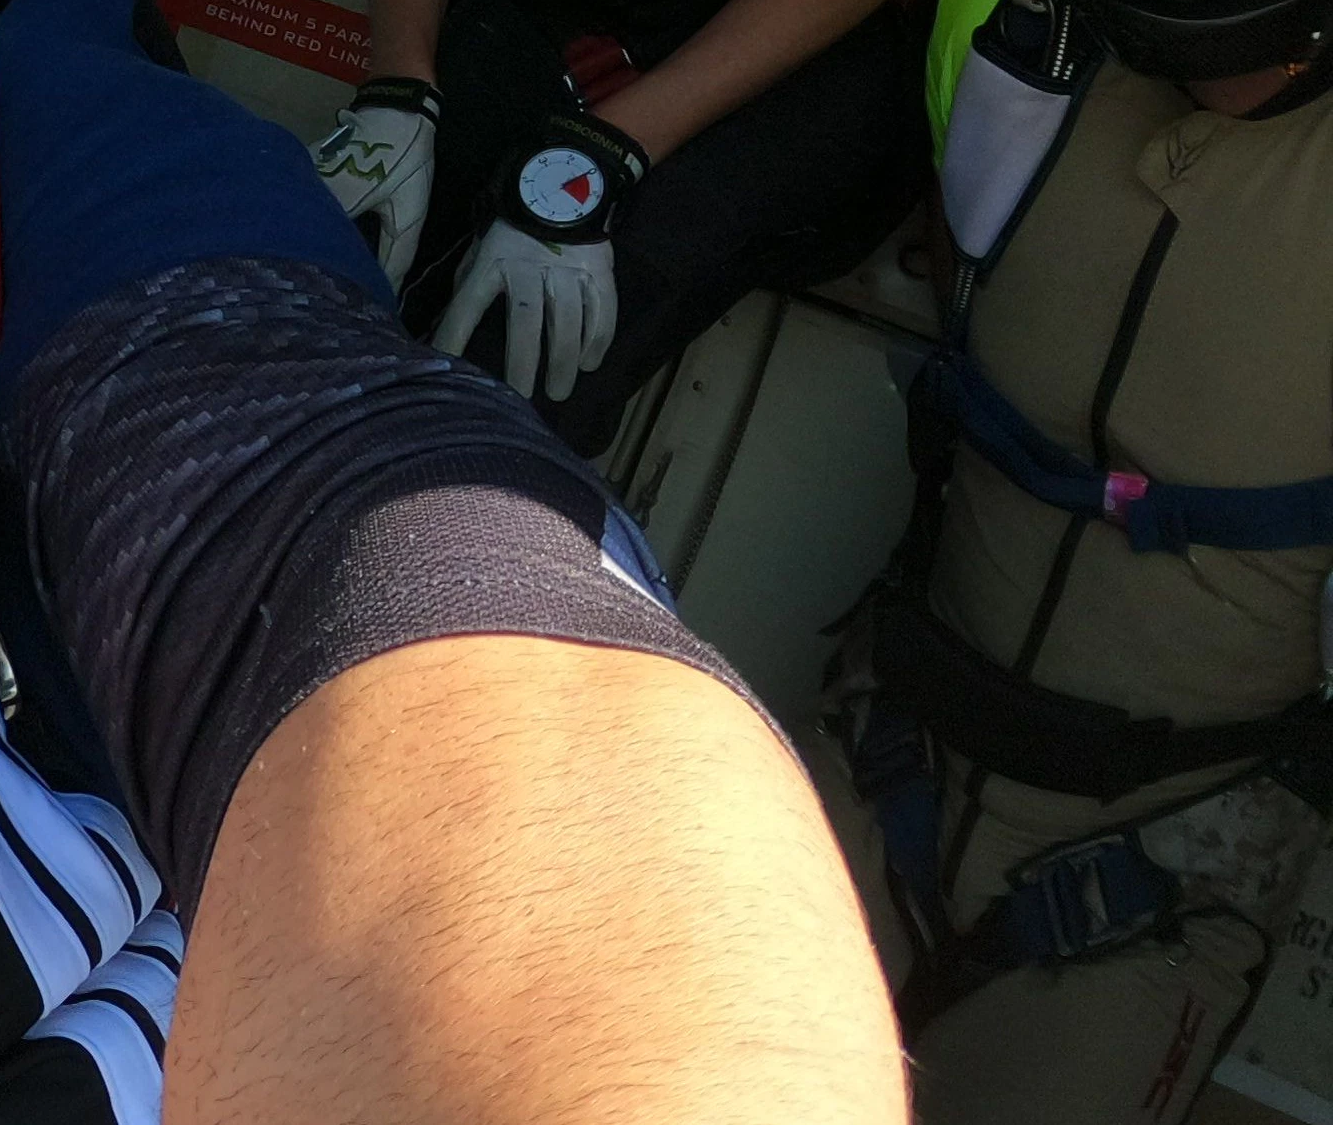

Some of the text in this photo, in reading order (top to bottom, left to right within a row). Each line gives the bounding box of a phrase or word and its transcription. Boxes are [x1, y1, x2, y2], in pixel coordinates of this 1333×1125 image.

[205, 3, 372, 71] BEHIND RED LINE
[324, 24, 373, 48] PARA
